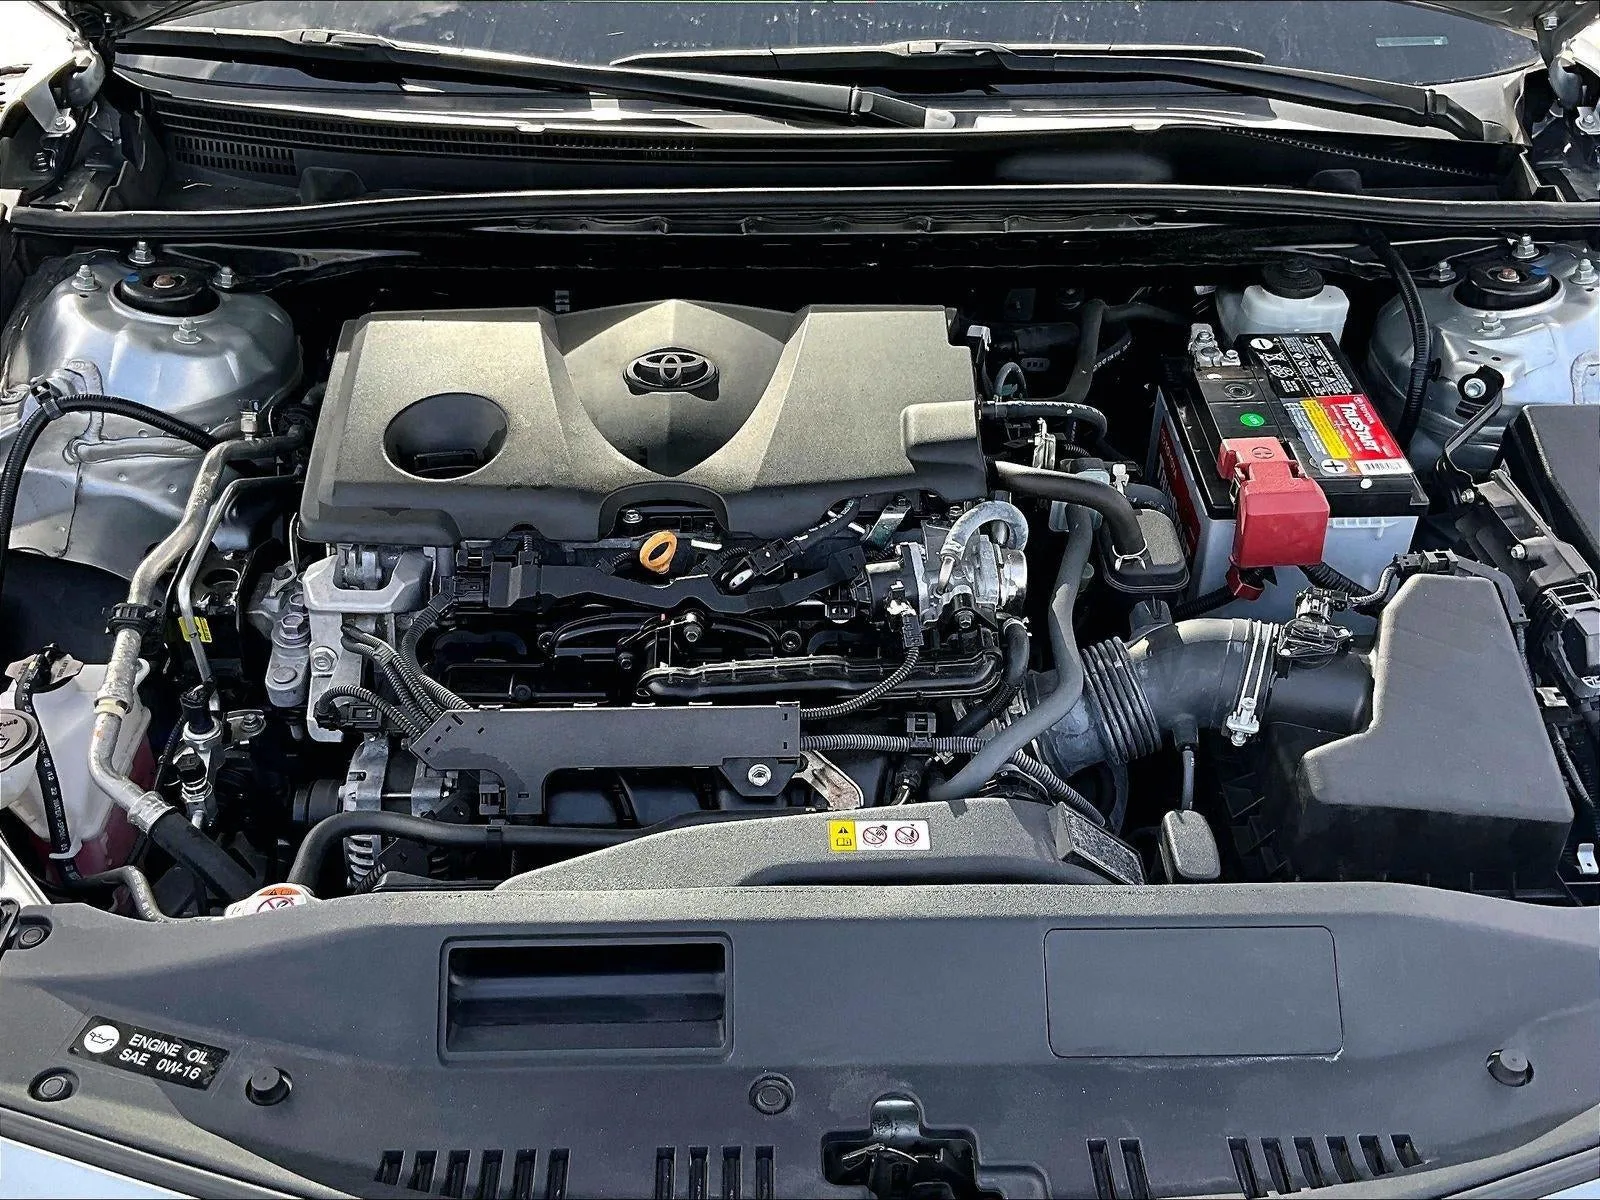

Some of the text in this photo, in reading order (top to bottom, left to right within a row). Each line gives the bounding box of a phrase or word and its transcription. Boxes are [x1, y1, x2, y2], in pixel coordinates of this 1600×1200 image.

[118, 1048, 202, 1080] SAE 0W-16
[128, 1033, 209, 1065] ENGINE OIL
